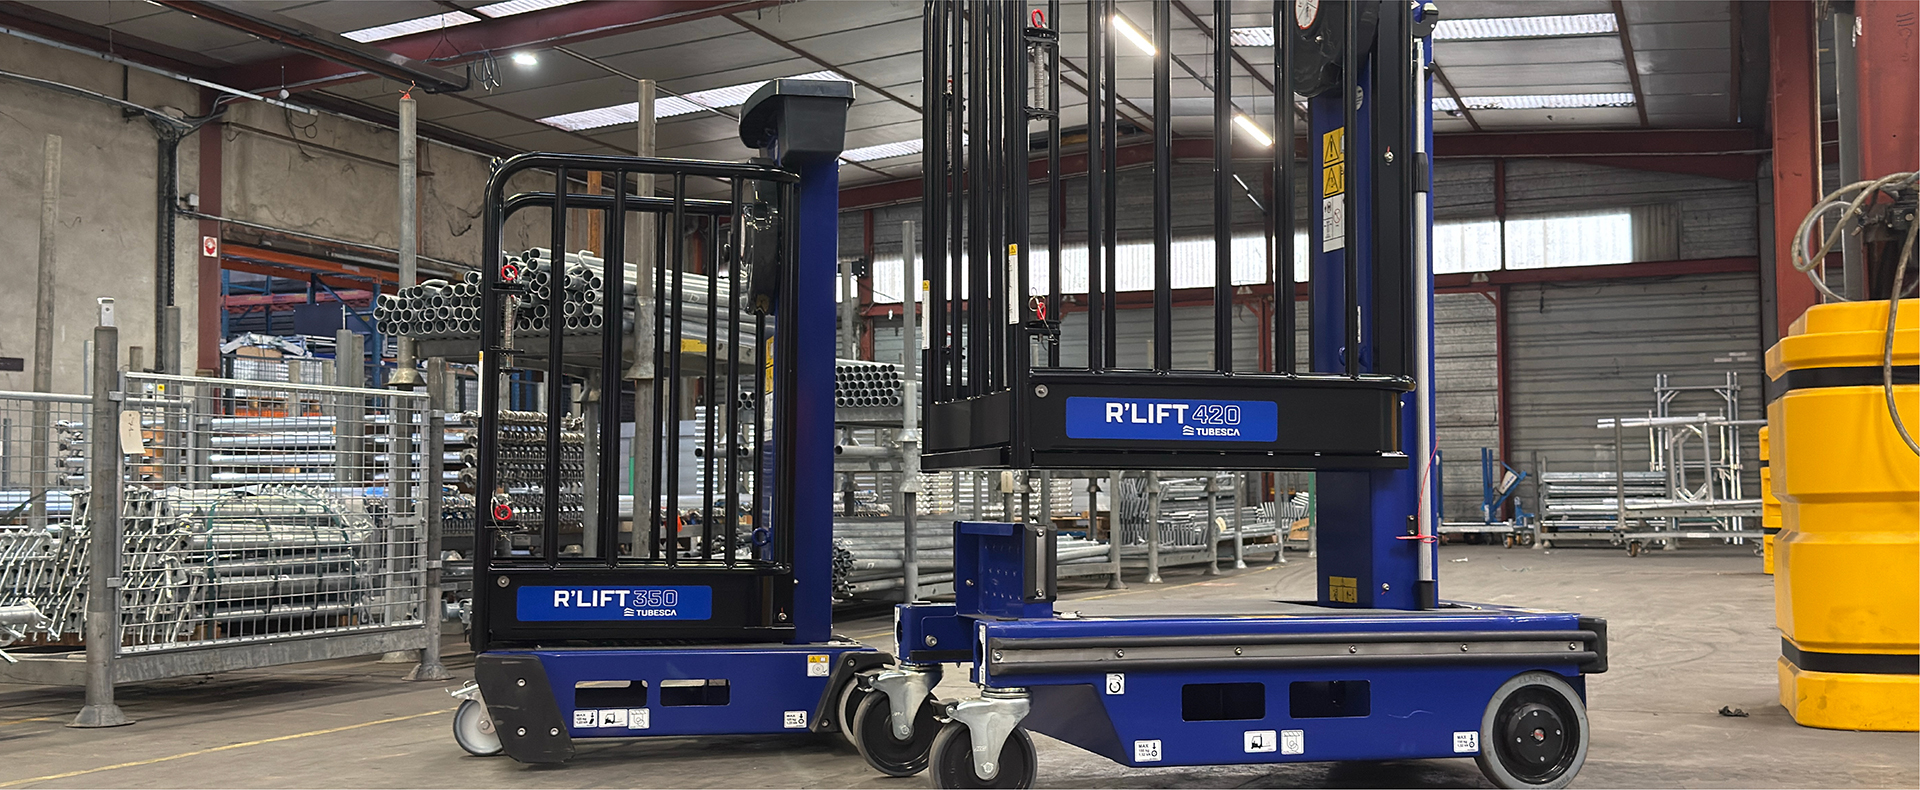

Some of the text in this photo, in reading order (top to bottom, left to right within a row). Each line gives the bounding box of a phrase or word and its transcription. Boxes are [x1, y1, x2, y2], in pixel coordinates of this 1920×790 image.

[1105, 402, 1241, 425] R’LIFT 420
[1196, 427, 1240, 436] TUBESCA
[553, 589, 678, 607] R’LIFT 350
[636, 609, 677, 617] TUBESCA
